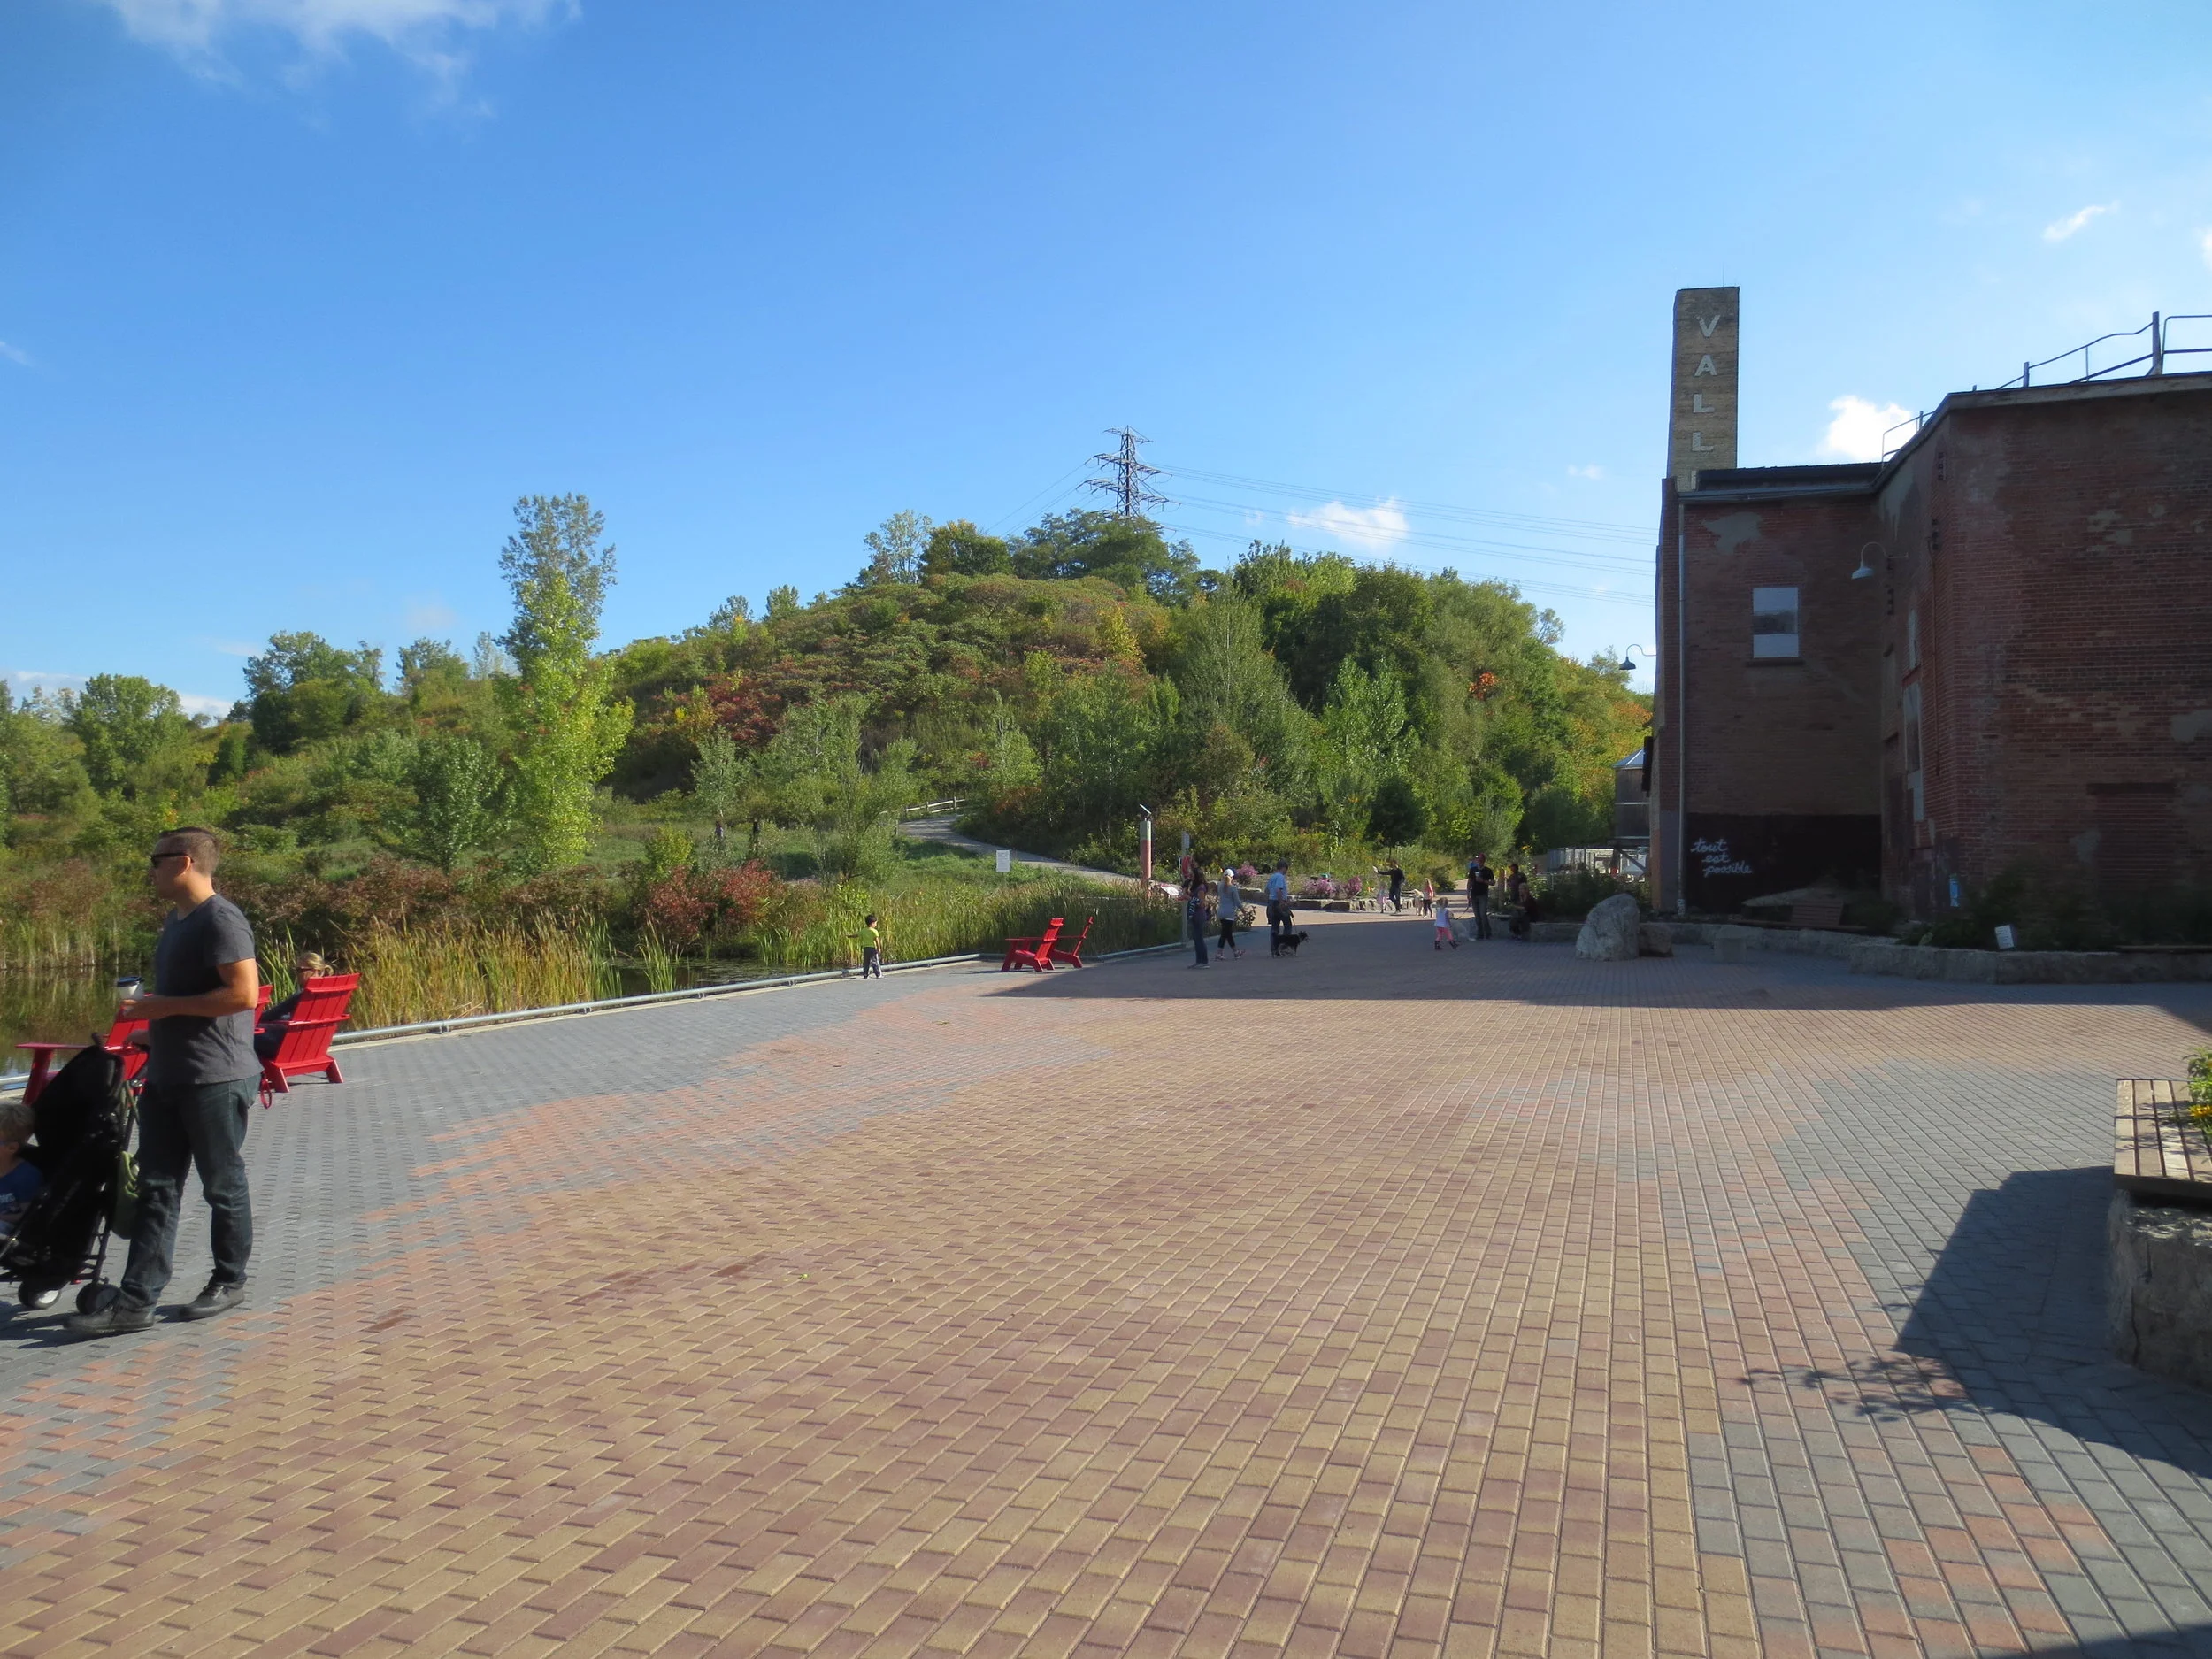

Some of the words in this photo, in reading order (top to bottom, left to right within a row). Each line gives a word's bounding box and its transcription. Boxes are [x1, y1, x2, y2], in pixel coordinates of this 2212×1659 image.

[1691, 314, 1721, 490] VALL
[1690, 837, 1729, 852] tout
[1701, 851, 1732, 864] est
[1702, 860, 1753, 878] possible
